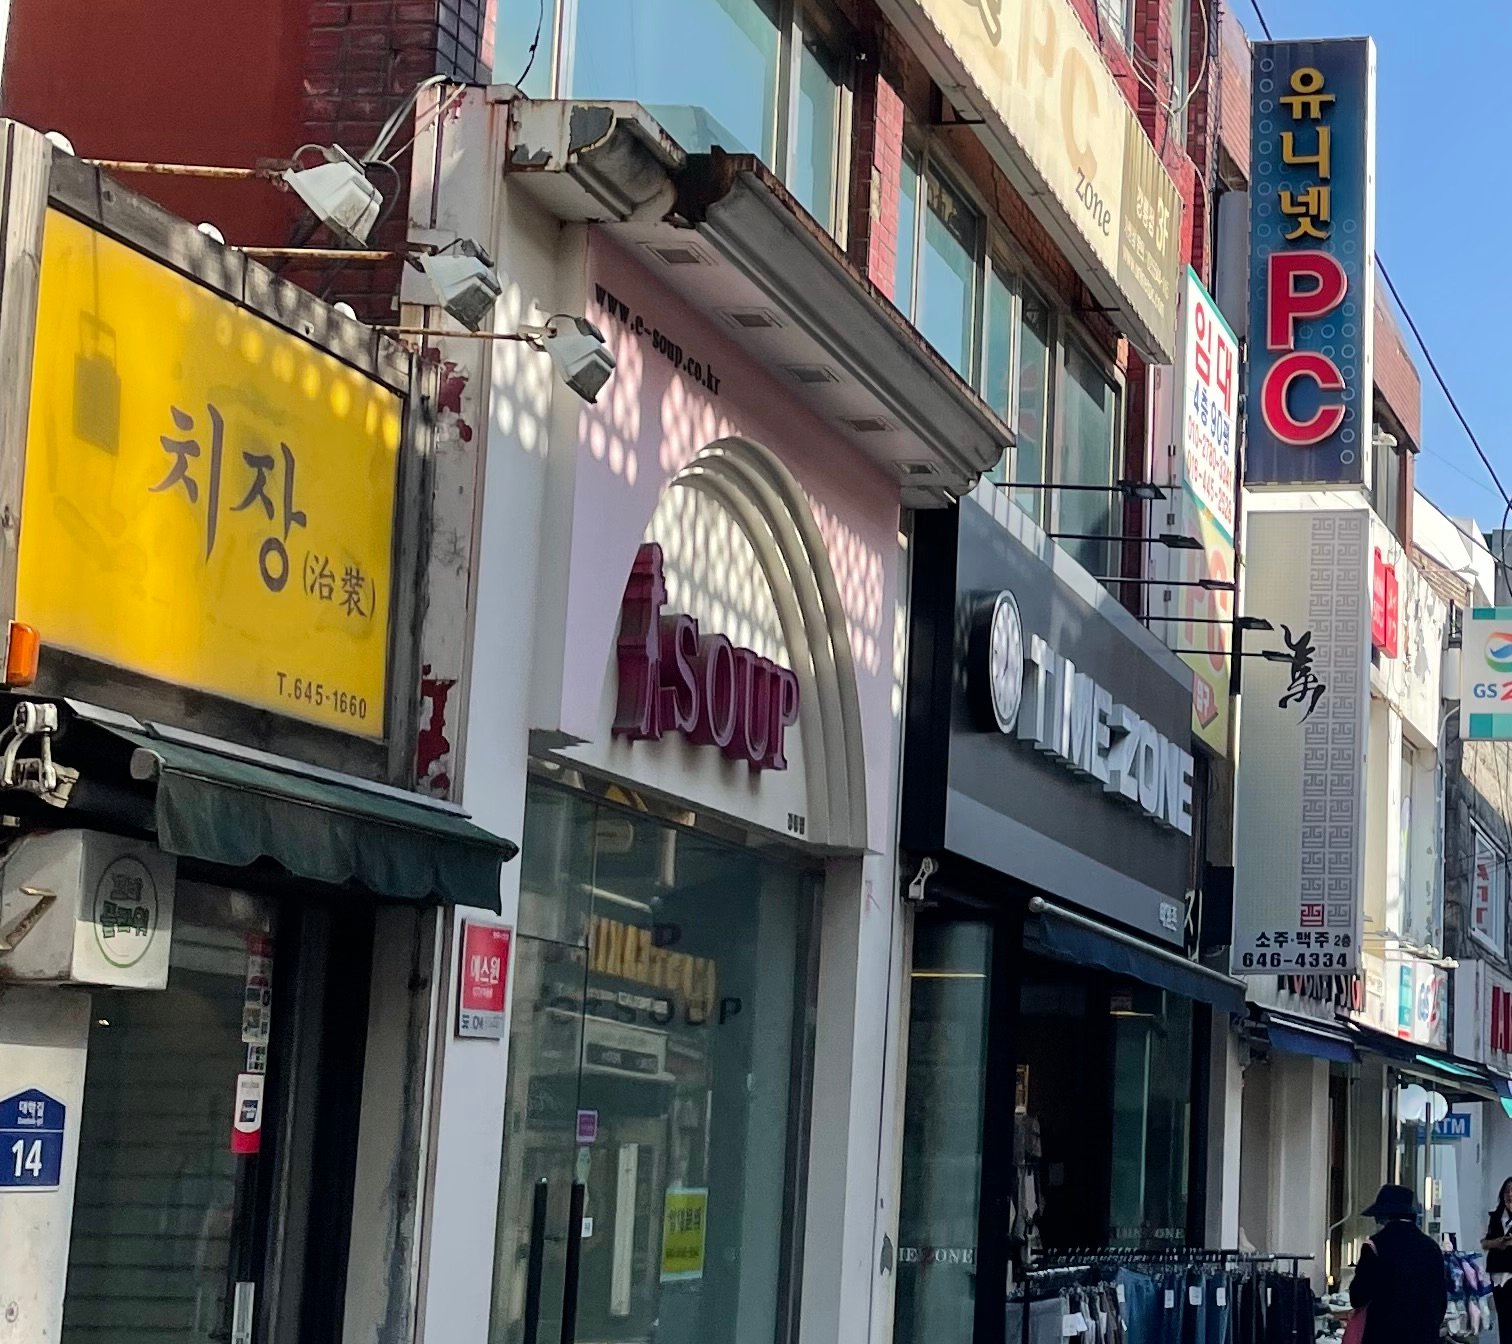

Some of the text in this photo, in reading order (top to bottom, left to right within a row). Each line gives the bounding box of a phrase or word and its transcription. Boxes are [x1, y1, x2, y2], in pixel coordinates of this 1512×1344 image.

[1074, 161, 1113, 239] zone
[1261, 66, 1348, 446] 유니넷 PC
[595, 282, 721, 396] www.e-soup.co.kr
[1195, 301, 1233, 417] 임대
[148, 402, 306, 594] 치장
[276, 670, 368, 721] T.645-1660
[661, 613, 800, 771] SOUP
[1242, 952, 1348, 968] 646-4334
[12, 1139, 43, 1178] 14
